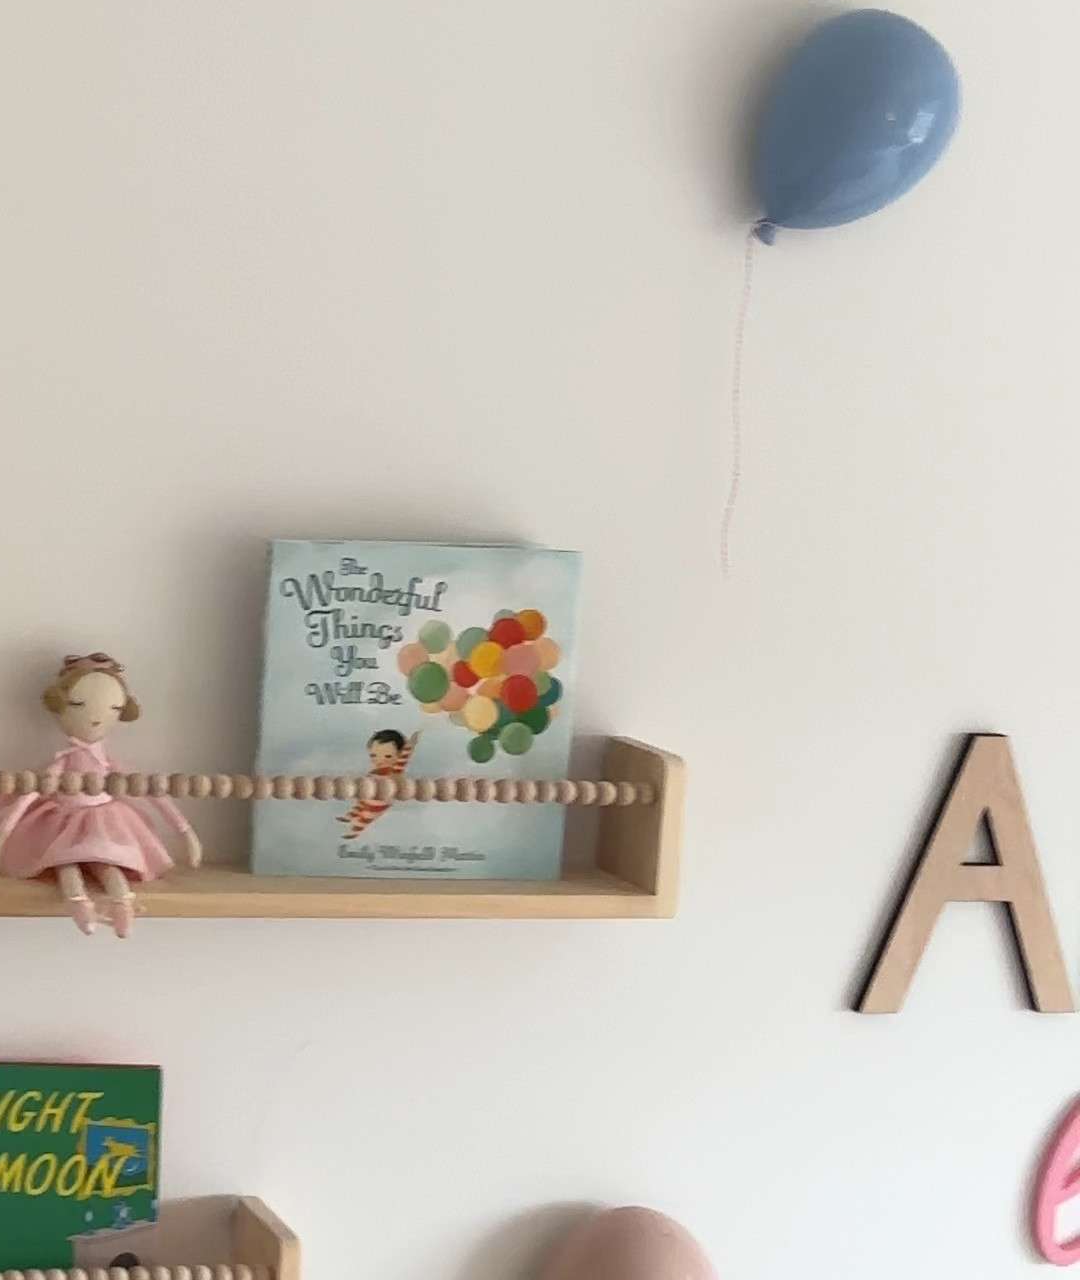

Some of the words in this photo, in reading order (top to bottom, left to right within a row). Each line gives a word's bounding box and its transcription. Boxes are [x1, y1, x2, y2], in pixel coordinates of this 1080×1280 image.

[280, 570, 448, 616] Wonderful
[304, 608, 404, 649] Things
[330, 645, 379, 677] You
[304, 681, 365, 705] Will
[366, 681, 403, 705] Be
